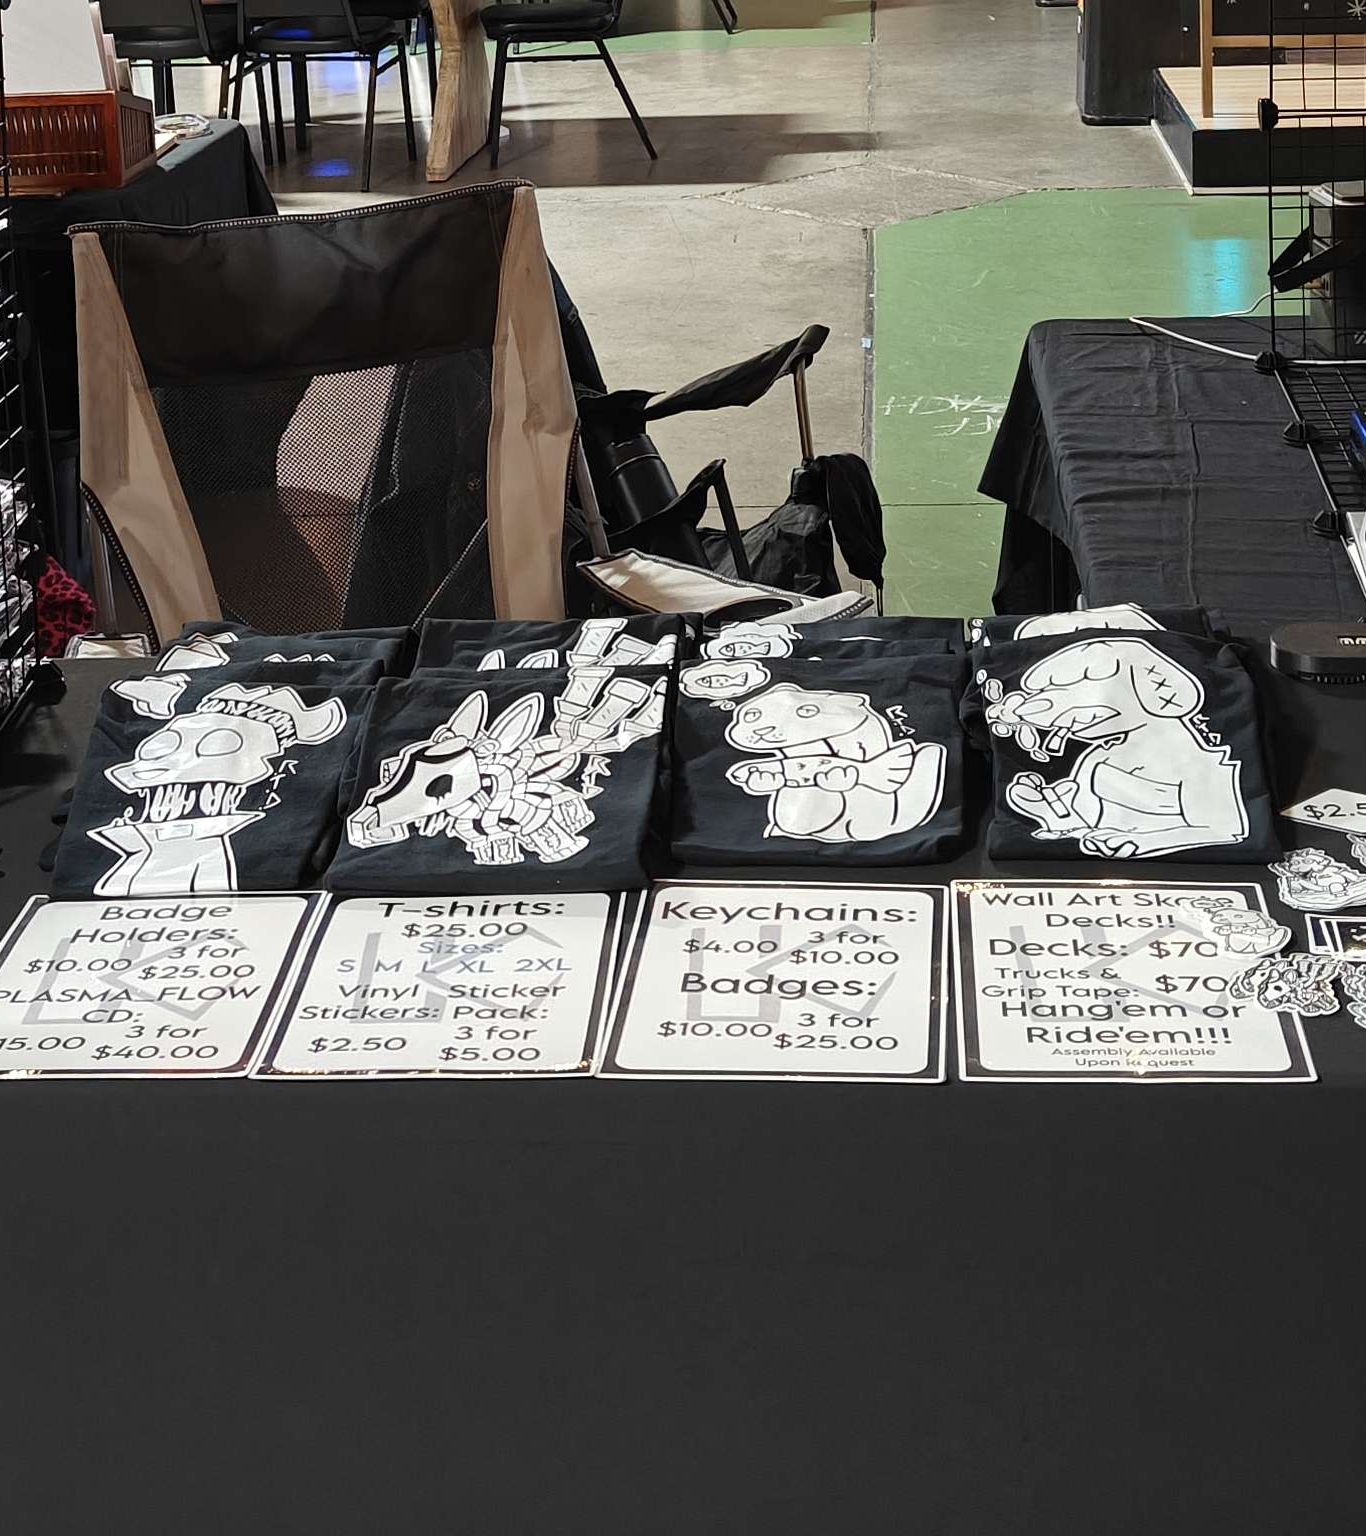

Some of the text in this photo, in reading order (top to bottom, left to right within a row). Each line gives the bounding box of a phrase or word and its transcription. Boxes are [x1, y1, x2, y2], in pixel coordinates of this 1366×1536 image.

[982, 893, 1054, 907] Wall
[1066, 893, 1122, 907] Art
[100, 904, 233, 922] Badge
[379, 901, 566, 917] T-shirts:
[661, 901, 918, 924] Keychains:
[1046, 913, 1175, 929] Decks!!
[69, 927, 239, 944] Holders:
[401, 922, 528, 938] $25.00
[807, 931, 886, 944] 3 for
[167, 945, 248, 959] 3 for
[418, 941, 503, 954] Sizes:
[683, 939, 778, 954] $4.00
[990, 938, 1129, 957] Decks:
[789, 949, 900, 965] $10.00
[23, 959, 132, 973] $10.00
[137, 964, 256, 980] $25.00
[337, 958, 573, 973] S M L XL 2XL
[994, 966, 1123, 980] Trucks &
[339, 983, 567, 1000] Vinyl Sticker
[680, 972, 878, 1000] Badges:
[982, 985, 1141, 1000] Grip Tape:
[1155, 975, 1229, 994] $70
[82, 1009, 140, 1024] CD:
[299, 1005, 549, 1020] Stickers: Pack:
[1002, 1000, 1248, 1020] Hang'em or
[797, 1013, 880, 1028] 3 for
[124, 1025, 209, 1039] 3 for
[454, 1026, 537, 1040] 3 for
[657, 1021, 773, 1038] $10.00
[1026, 1026, 1234, 1044] Ride'em!!!
[307, 1037, 408, 1053] $2.50
[772, 1034, 899, 1050] $25.00
[91, 1045, 219, 1061] $40.00
[438, 1047, 541, 1063] $5.00
[1051, 1046, 1217, 1057] Assembly Available
[1075, 1058, 1122, 1068] Upon
